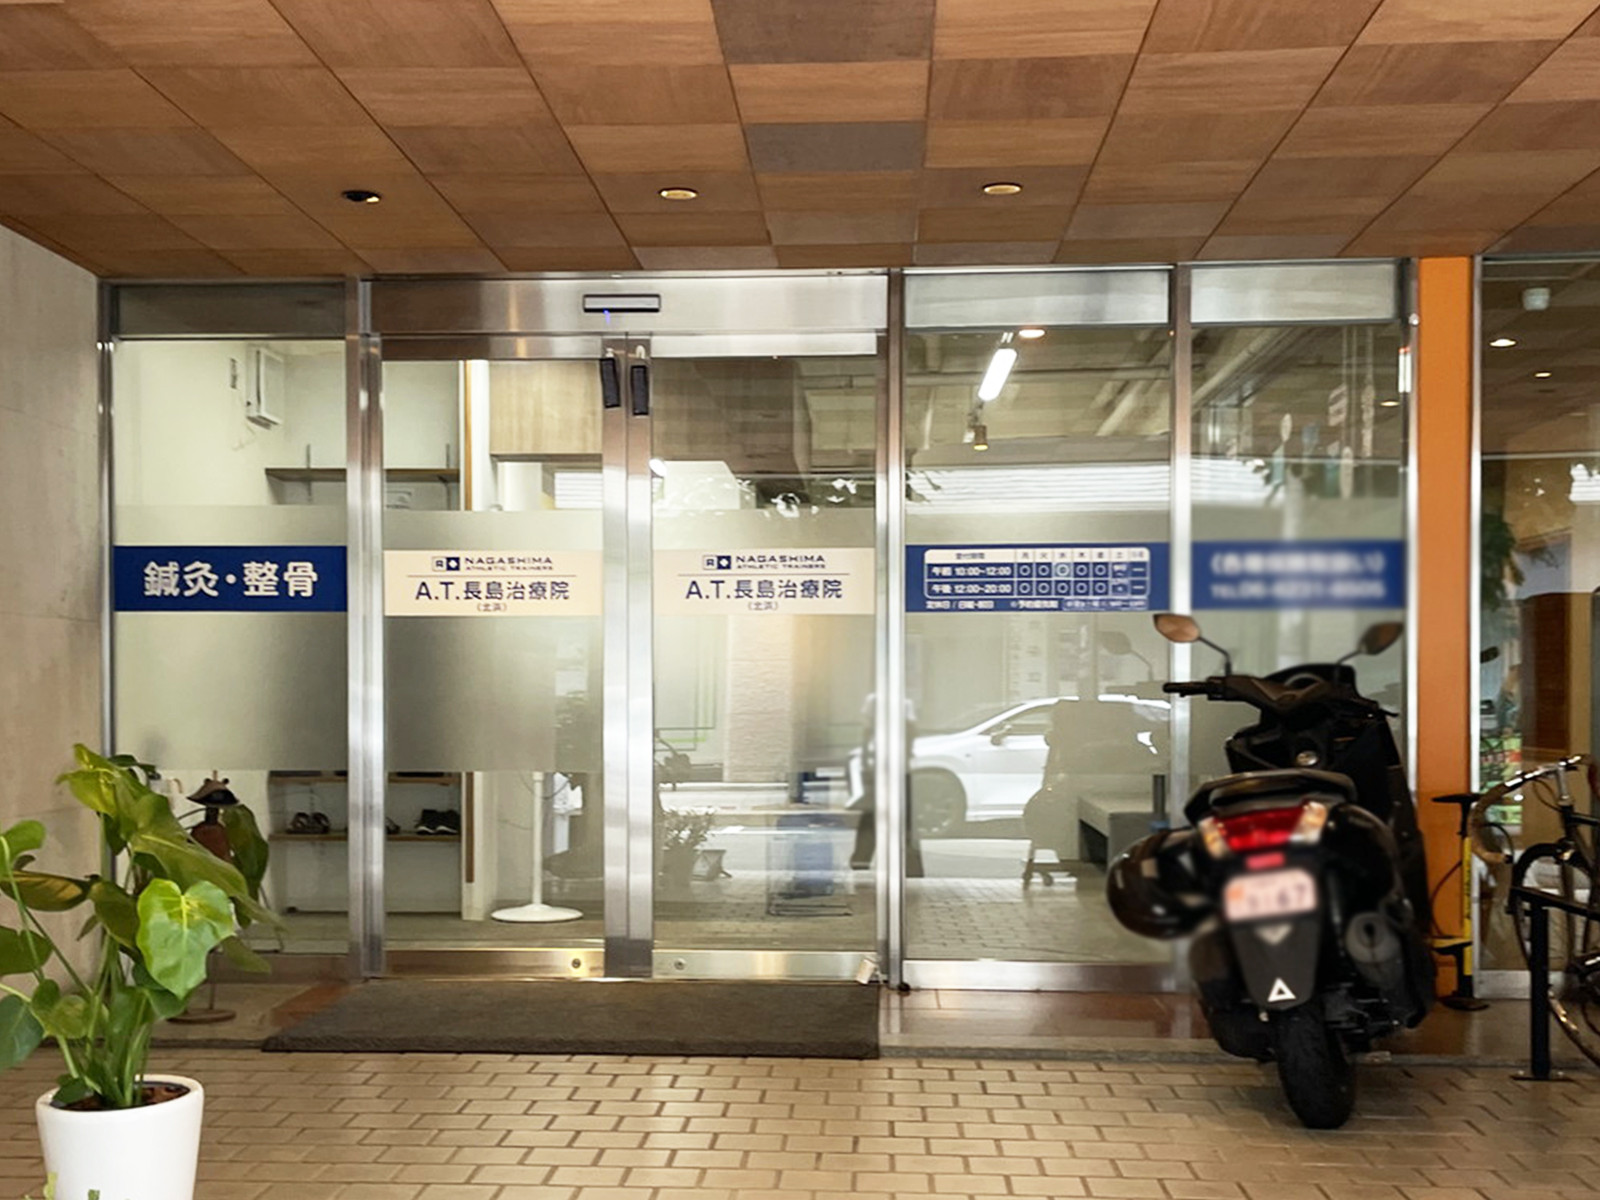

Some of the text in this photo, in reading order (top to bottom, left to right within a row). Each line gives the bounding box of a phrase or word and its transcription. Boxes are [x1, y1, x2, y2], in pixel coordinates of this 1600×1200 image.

[143, 561, 318, 597] 鍼灸・整骨
[685, 579, 843, 600] A.T.長島治療院
[415, 581, 570, 600] A.T.長島治療院
